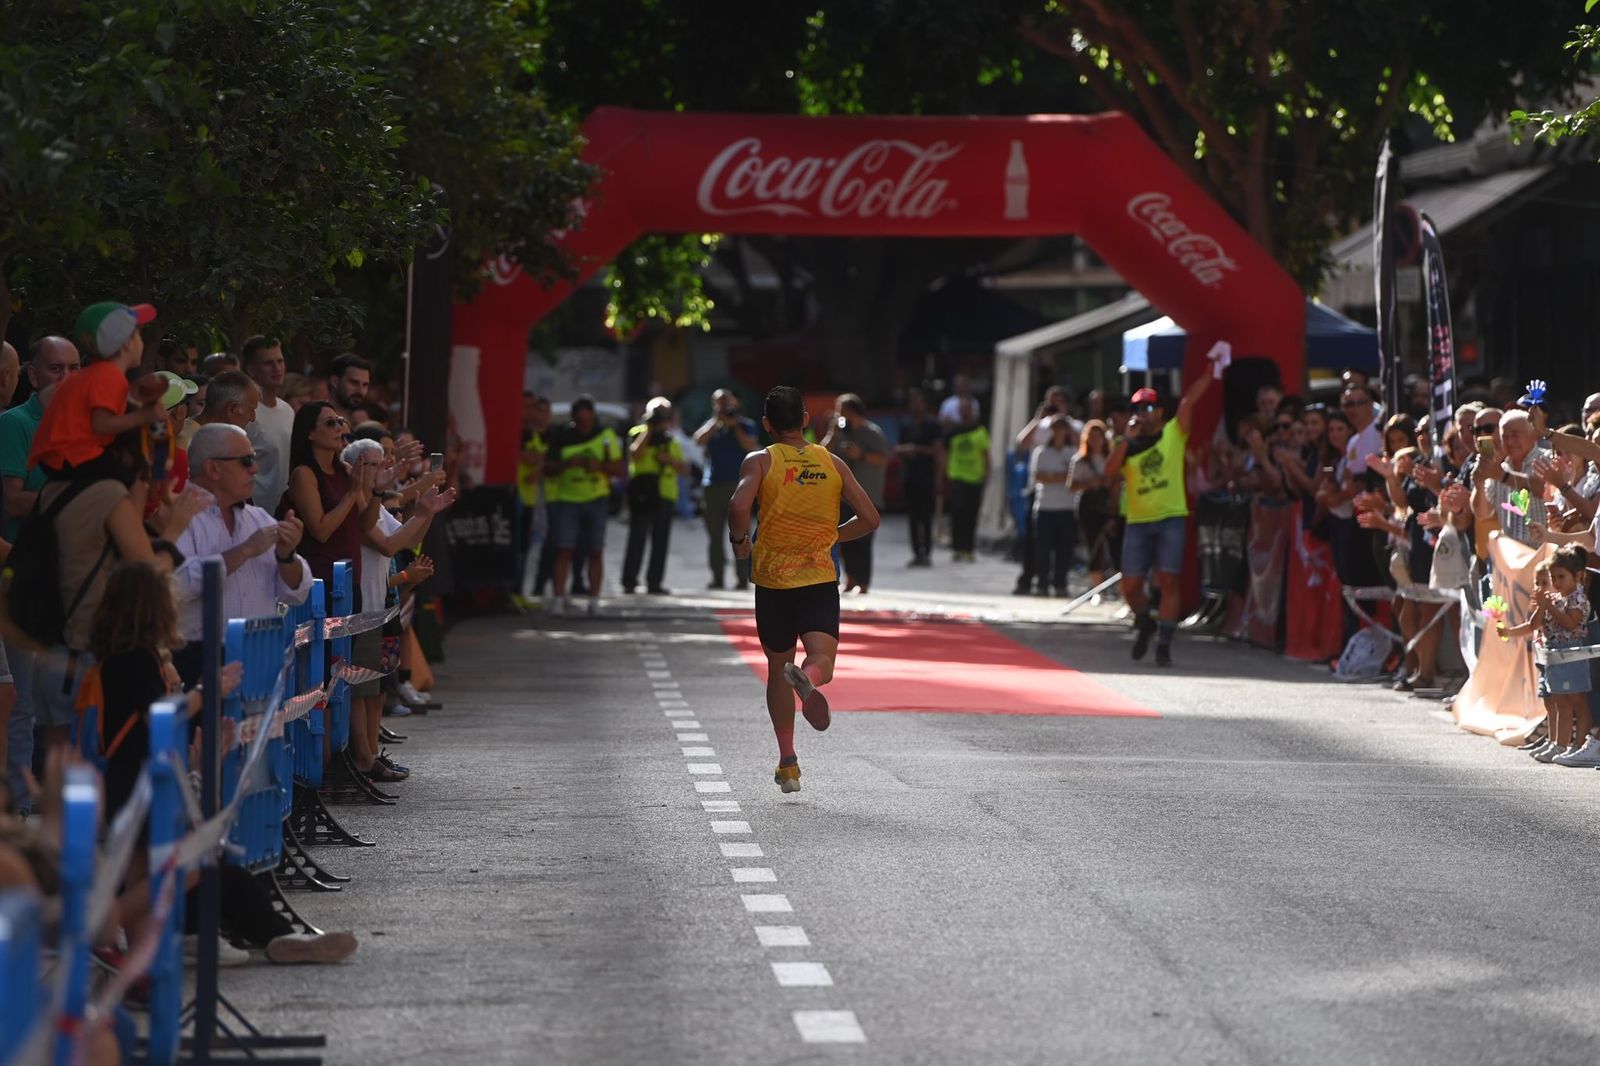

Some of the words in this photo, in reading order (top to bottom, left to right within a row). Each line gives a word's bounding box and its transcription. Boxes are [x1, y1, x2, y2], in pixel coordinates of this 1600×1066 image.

[697, 137, 965, 219] Coca-Cola
[1127, 192, 1240, 284] Coca-Cola
[798, 468, 828, 480] Álora
